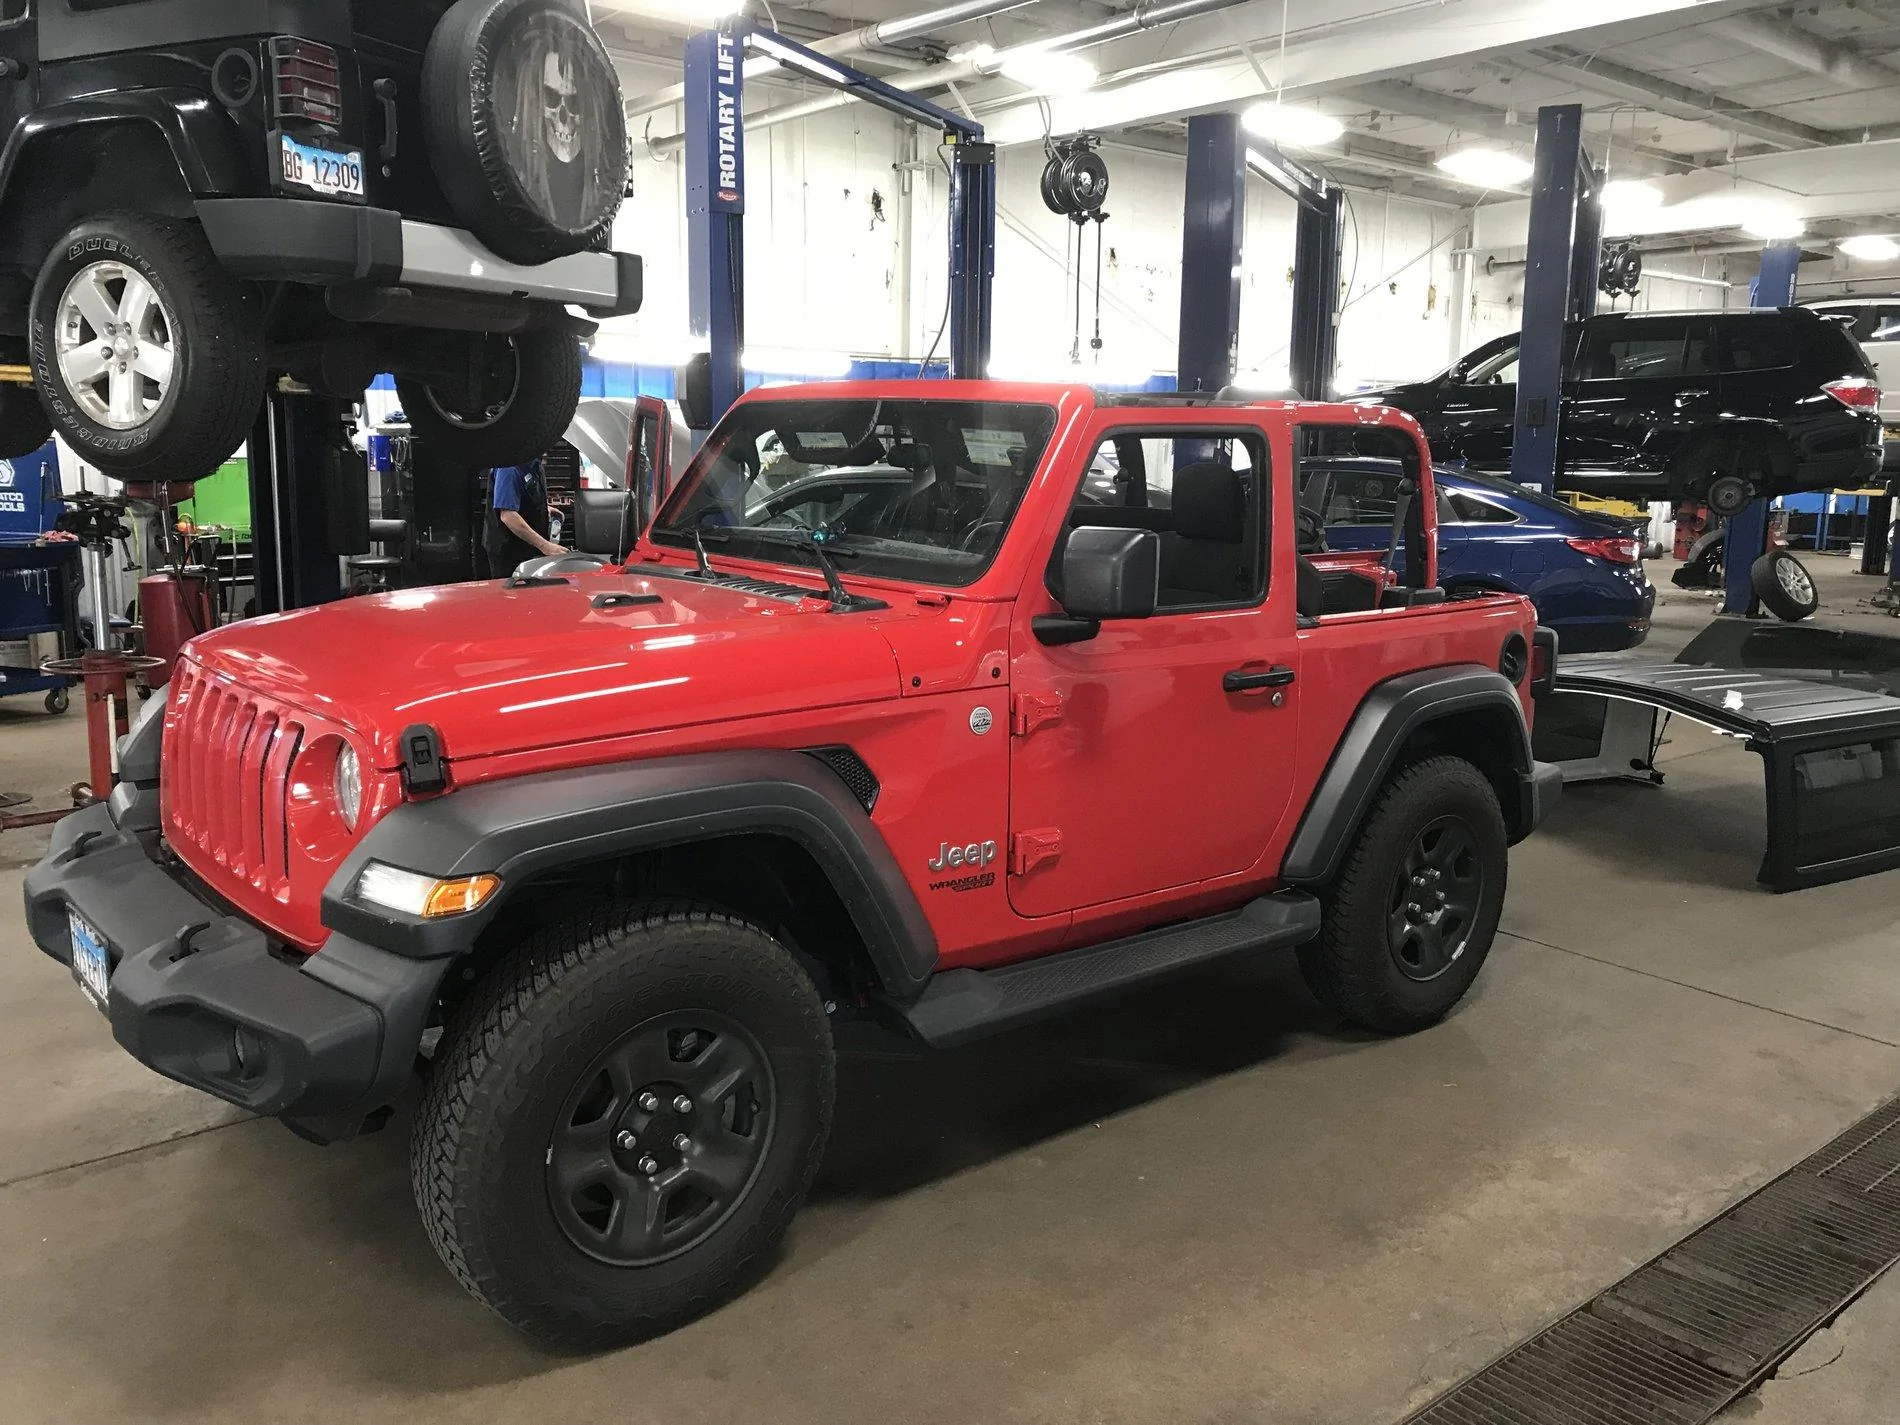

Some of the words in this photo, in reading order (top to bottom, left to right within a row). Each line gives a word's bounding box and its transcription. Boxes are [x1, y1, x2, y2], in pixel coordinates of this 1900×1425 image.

[717, 33, 735, 86] LIFT
[718, 90, 736, 189] ROTARY
[282, 149, 303, 180] BG
[312, 155, 360, 191] 12309
[0, 492, 24, 502] ATCO
[0, 502, 25, 512] OOLS
[928, 839, 998, 873] Jeep
[929, 871, 996, 891] WRANGLER
